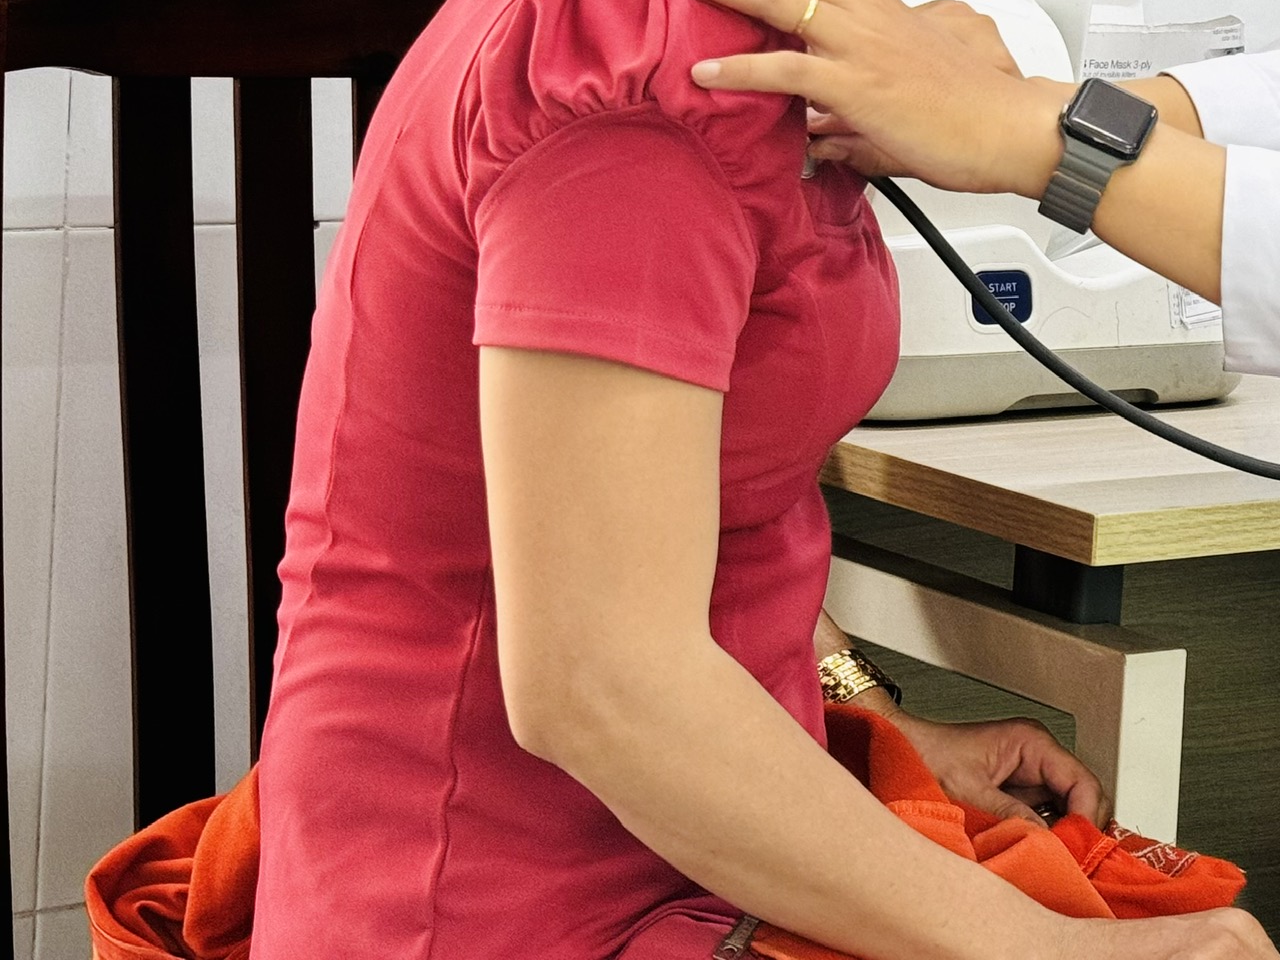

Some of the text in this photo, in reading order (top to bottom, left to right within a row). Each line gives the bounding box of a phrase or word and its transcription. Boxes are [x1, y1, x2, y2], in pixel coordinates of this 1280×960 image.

[1089, 59, 1152, 71] Face Mask 3-ply
[988, 281, 1017, 294] START
